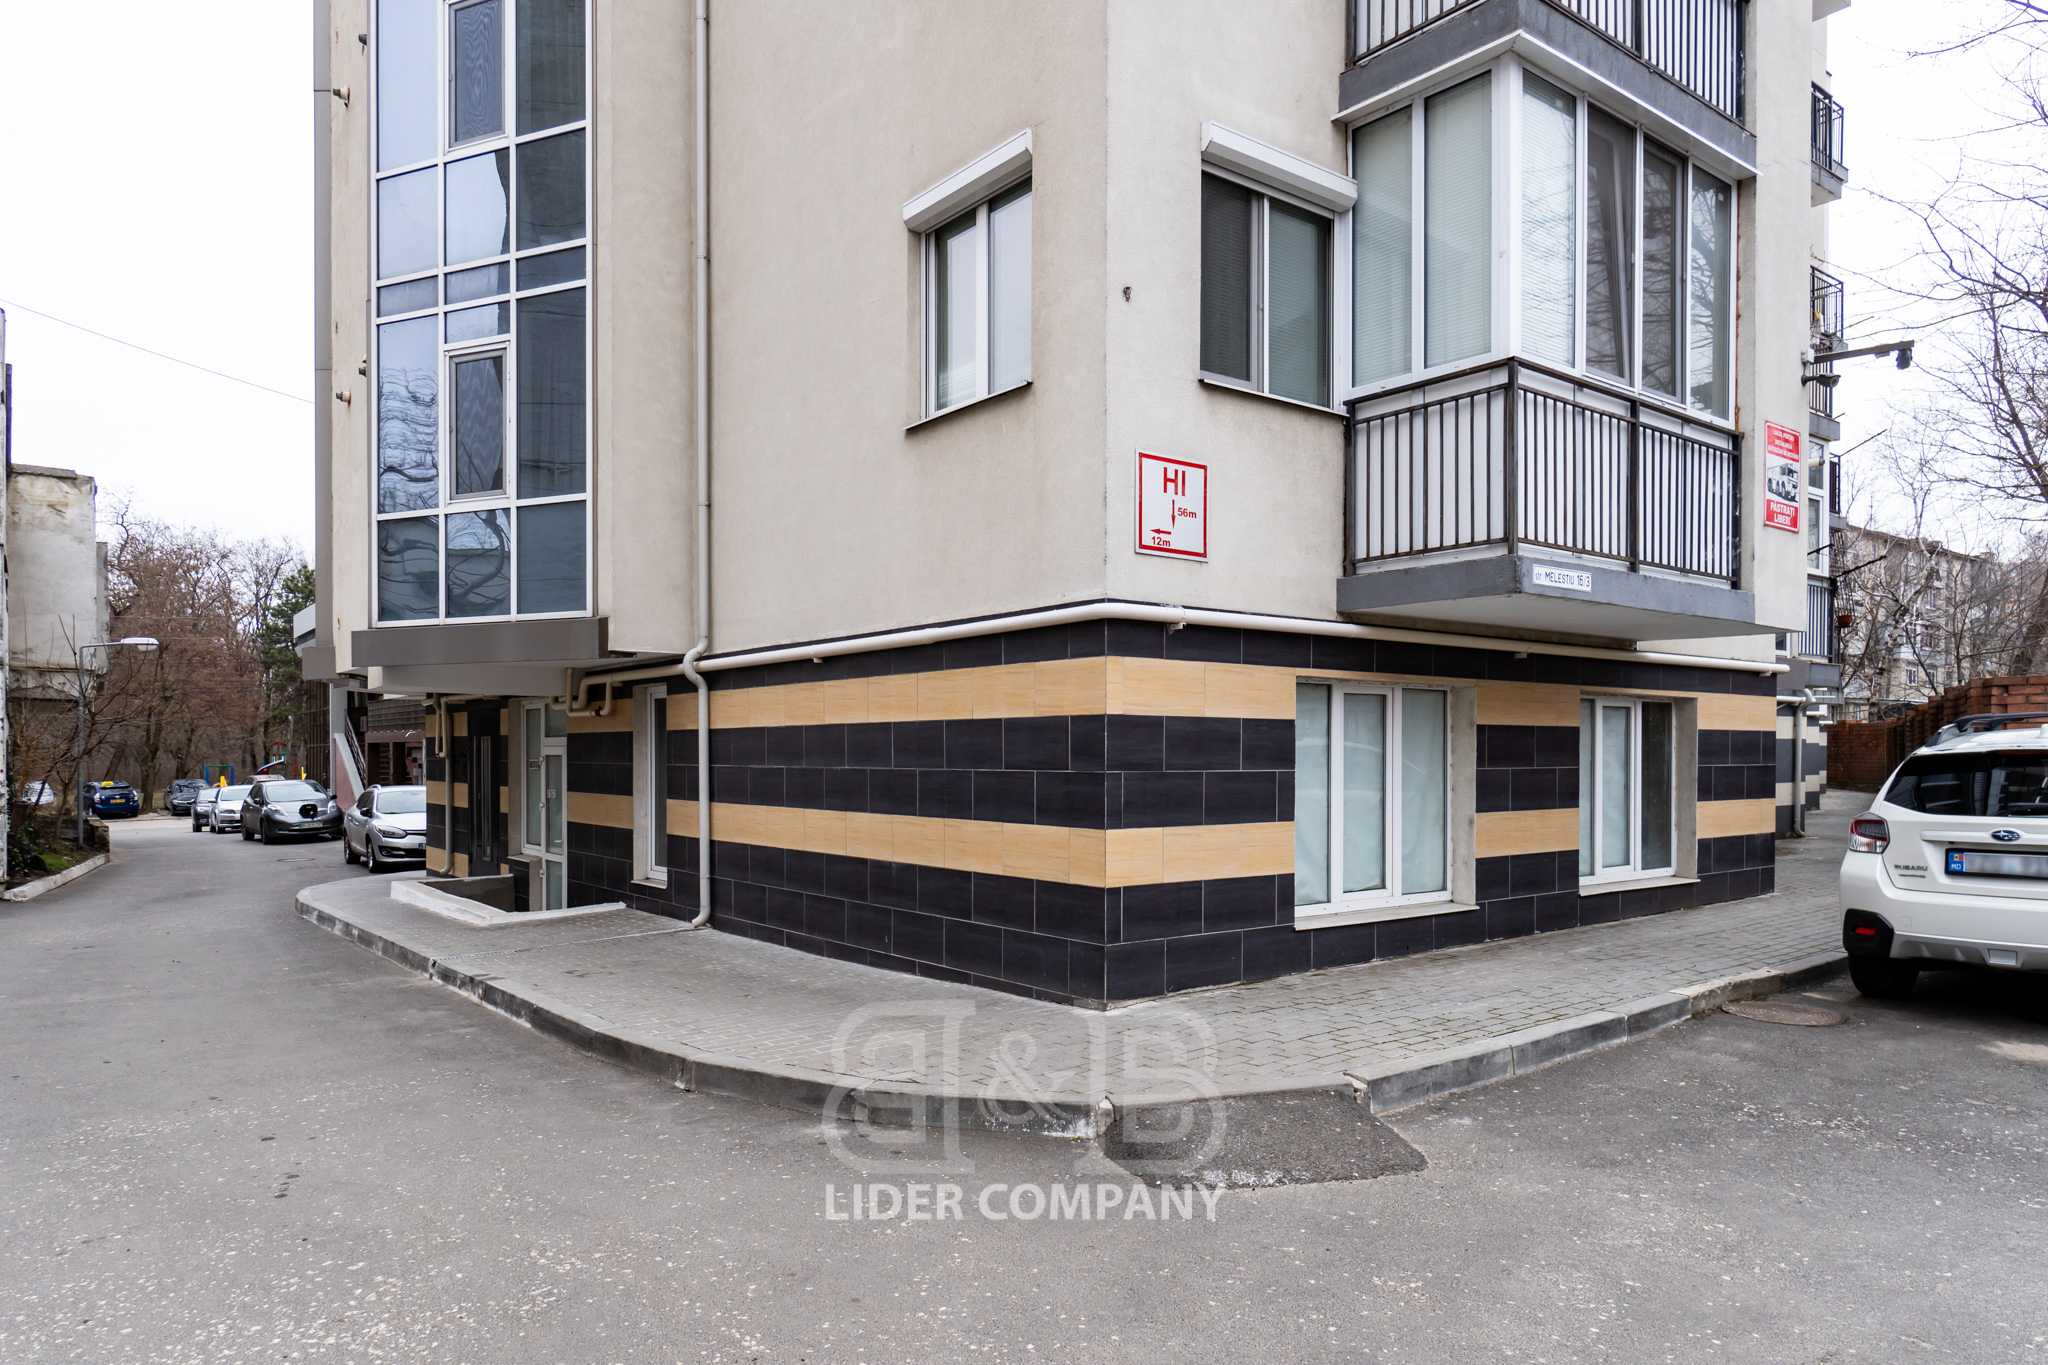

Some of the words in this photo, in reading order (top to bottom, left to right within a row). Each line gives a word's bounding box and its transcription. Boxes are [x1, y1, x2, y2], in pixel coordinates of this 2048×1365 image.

[1177, 507, 1197, 519] 56m
[1151, 536, 1171, 547] 12m
[1894, 864, 1928, 872] SUBARU
